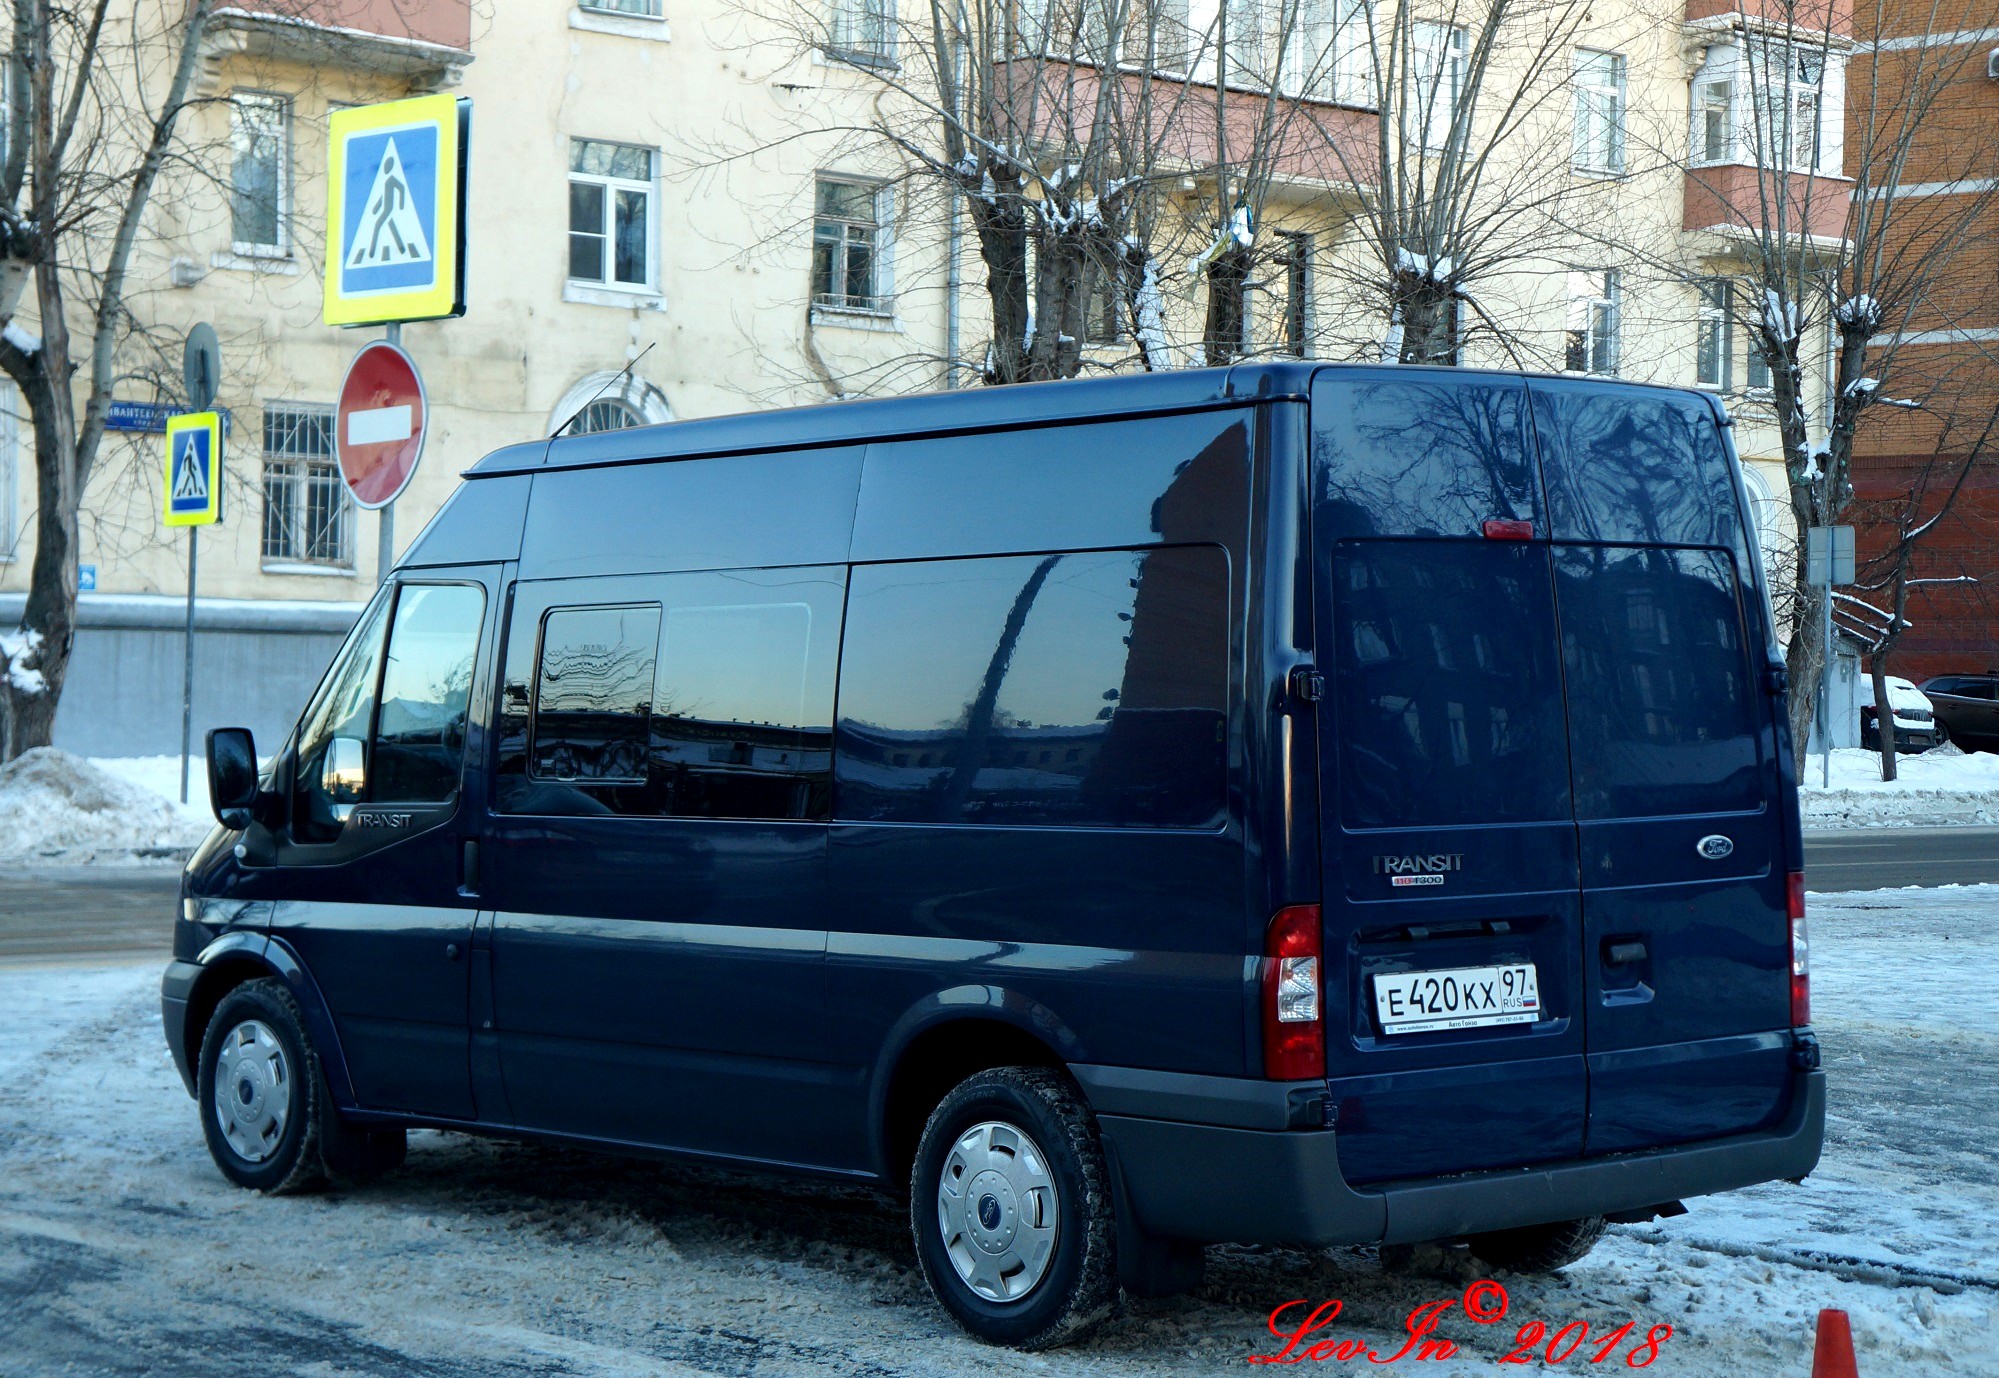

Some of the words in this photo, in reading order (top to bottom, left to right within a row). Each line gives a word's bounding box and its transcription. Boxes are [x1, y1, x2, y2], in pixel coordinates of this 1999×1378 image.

[356, 813, 411, 828] TRANSIT
[1372, 853, 1464, 874] TRANSIT
[1502, 969, 1526, 996] 97
[1503, 998, 1522, 1008] RUS
